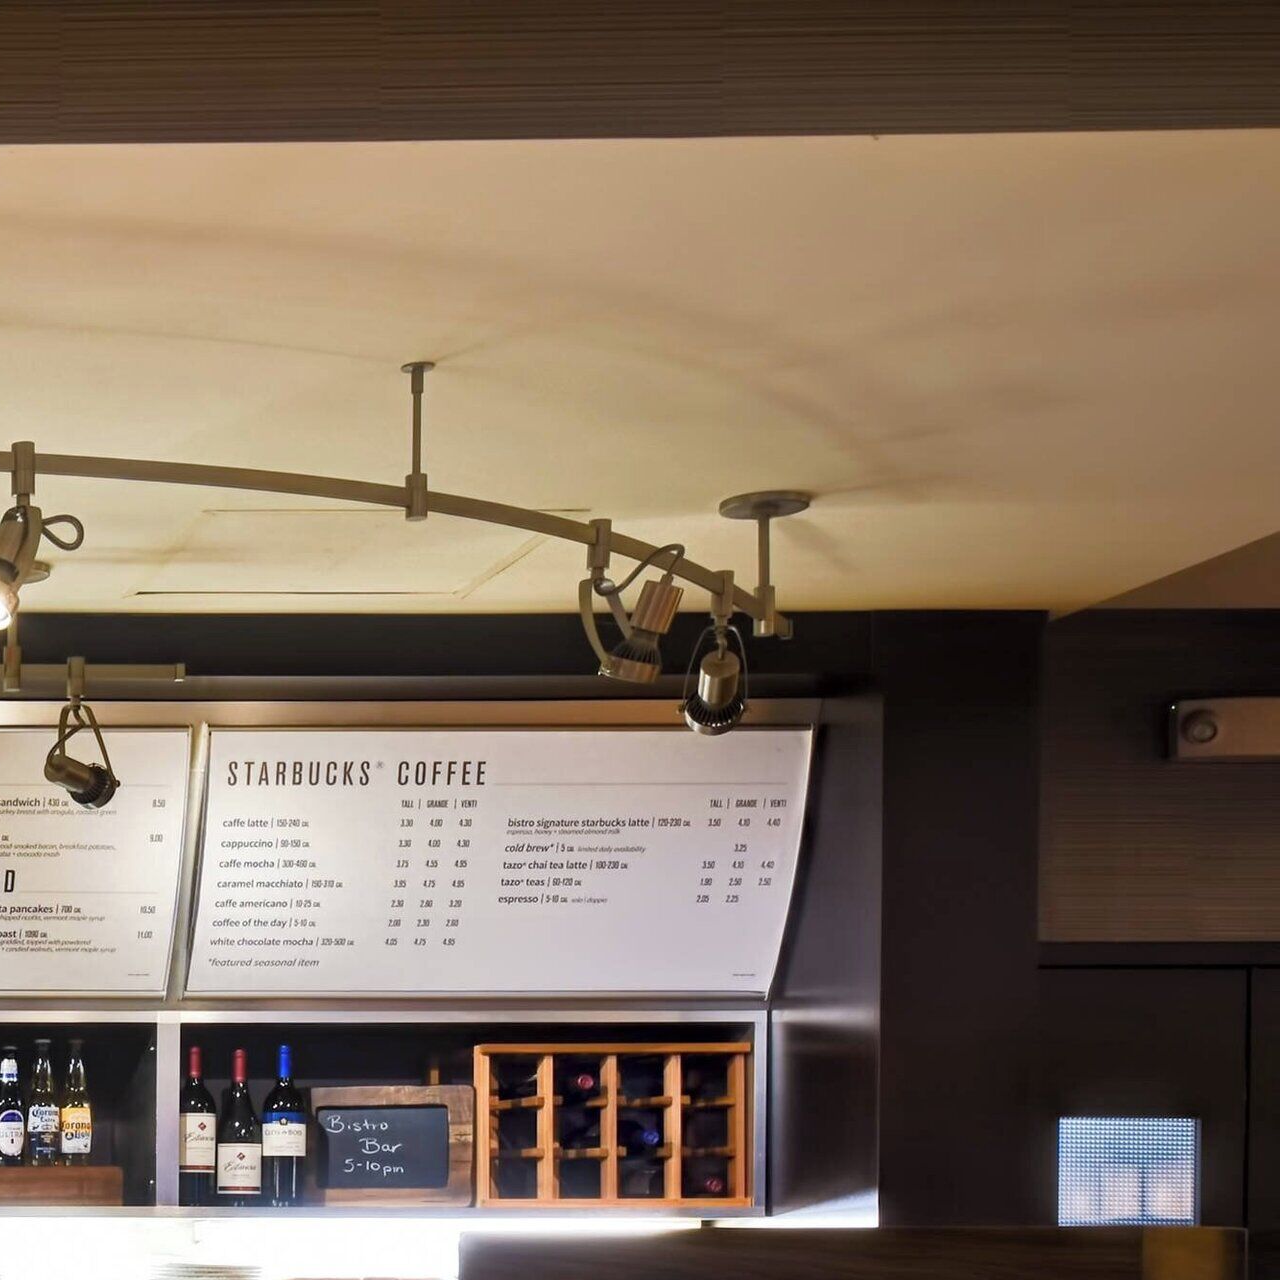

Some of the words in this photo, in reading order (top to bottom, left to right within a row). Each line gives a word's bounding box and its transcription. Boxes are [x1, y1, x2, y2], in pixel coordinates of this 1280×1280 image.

[398, 761, 486, 785] COFFEE
[402, 800, 413, 808] TALL
[427, 800, 448, 808] GRANDE
[461, 800, 477, 808] VENTI
[710, 799, 723, 808] TALL
[736, 799, 757, 808] GRANDE
[770, 799, 787, 807] VENTI
[223, 818, 245, 827] caffe
[247, 819, 268, 827] latte
[508, 818, 535, 827] bistro
[536, 818, 579, 830] signature
[582, 818, 626, 827] starbucks
[628, 818, 649, 827] latte
[221, 839, 273, 849] cappuccino
[505, 844, 525, 852] cold
[219, 859, 241, 868] caffe
[244, 860, 274, 868] mocha
[528, 860, 548, 869] chai
[547, 861, 564, 869] tea
[566, 861, 587, 869] latte
[217, 879, 254, 888] caramel
[256, 879, 303, 888] macchiato
[215, 899, 237, 908] caffe
[239, 899, 288, 908] americano
[498, 896, 538, 905] espresso
[10, 905, 53, 916] pancakes
[212, 918, 240, 927] coffee
[251, 918, 268, 927] the
[270, 919, 287, 928] day
[210, 938, 235, 946] white
[237, 938, 281, 946] chocolate
[283, 938, 313, 946] mocha
[254, 959, 297, 967] seasonal
[296, 959, 319, 968] item
[326, 1114, 390, 1134] Bistro
[358, 1137, 403, 1155] Bar
